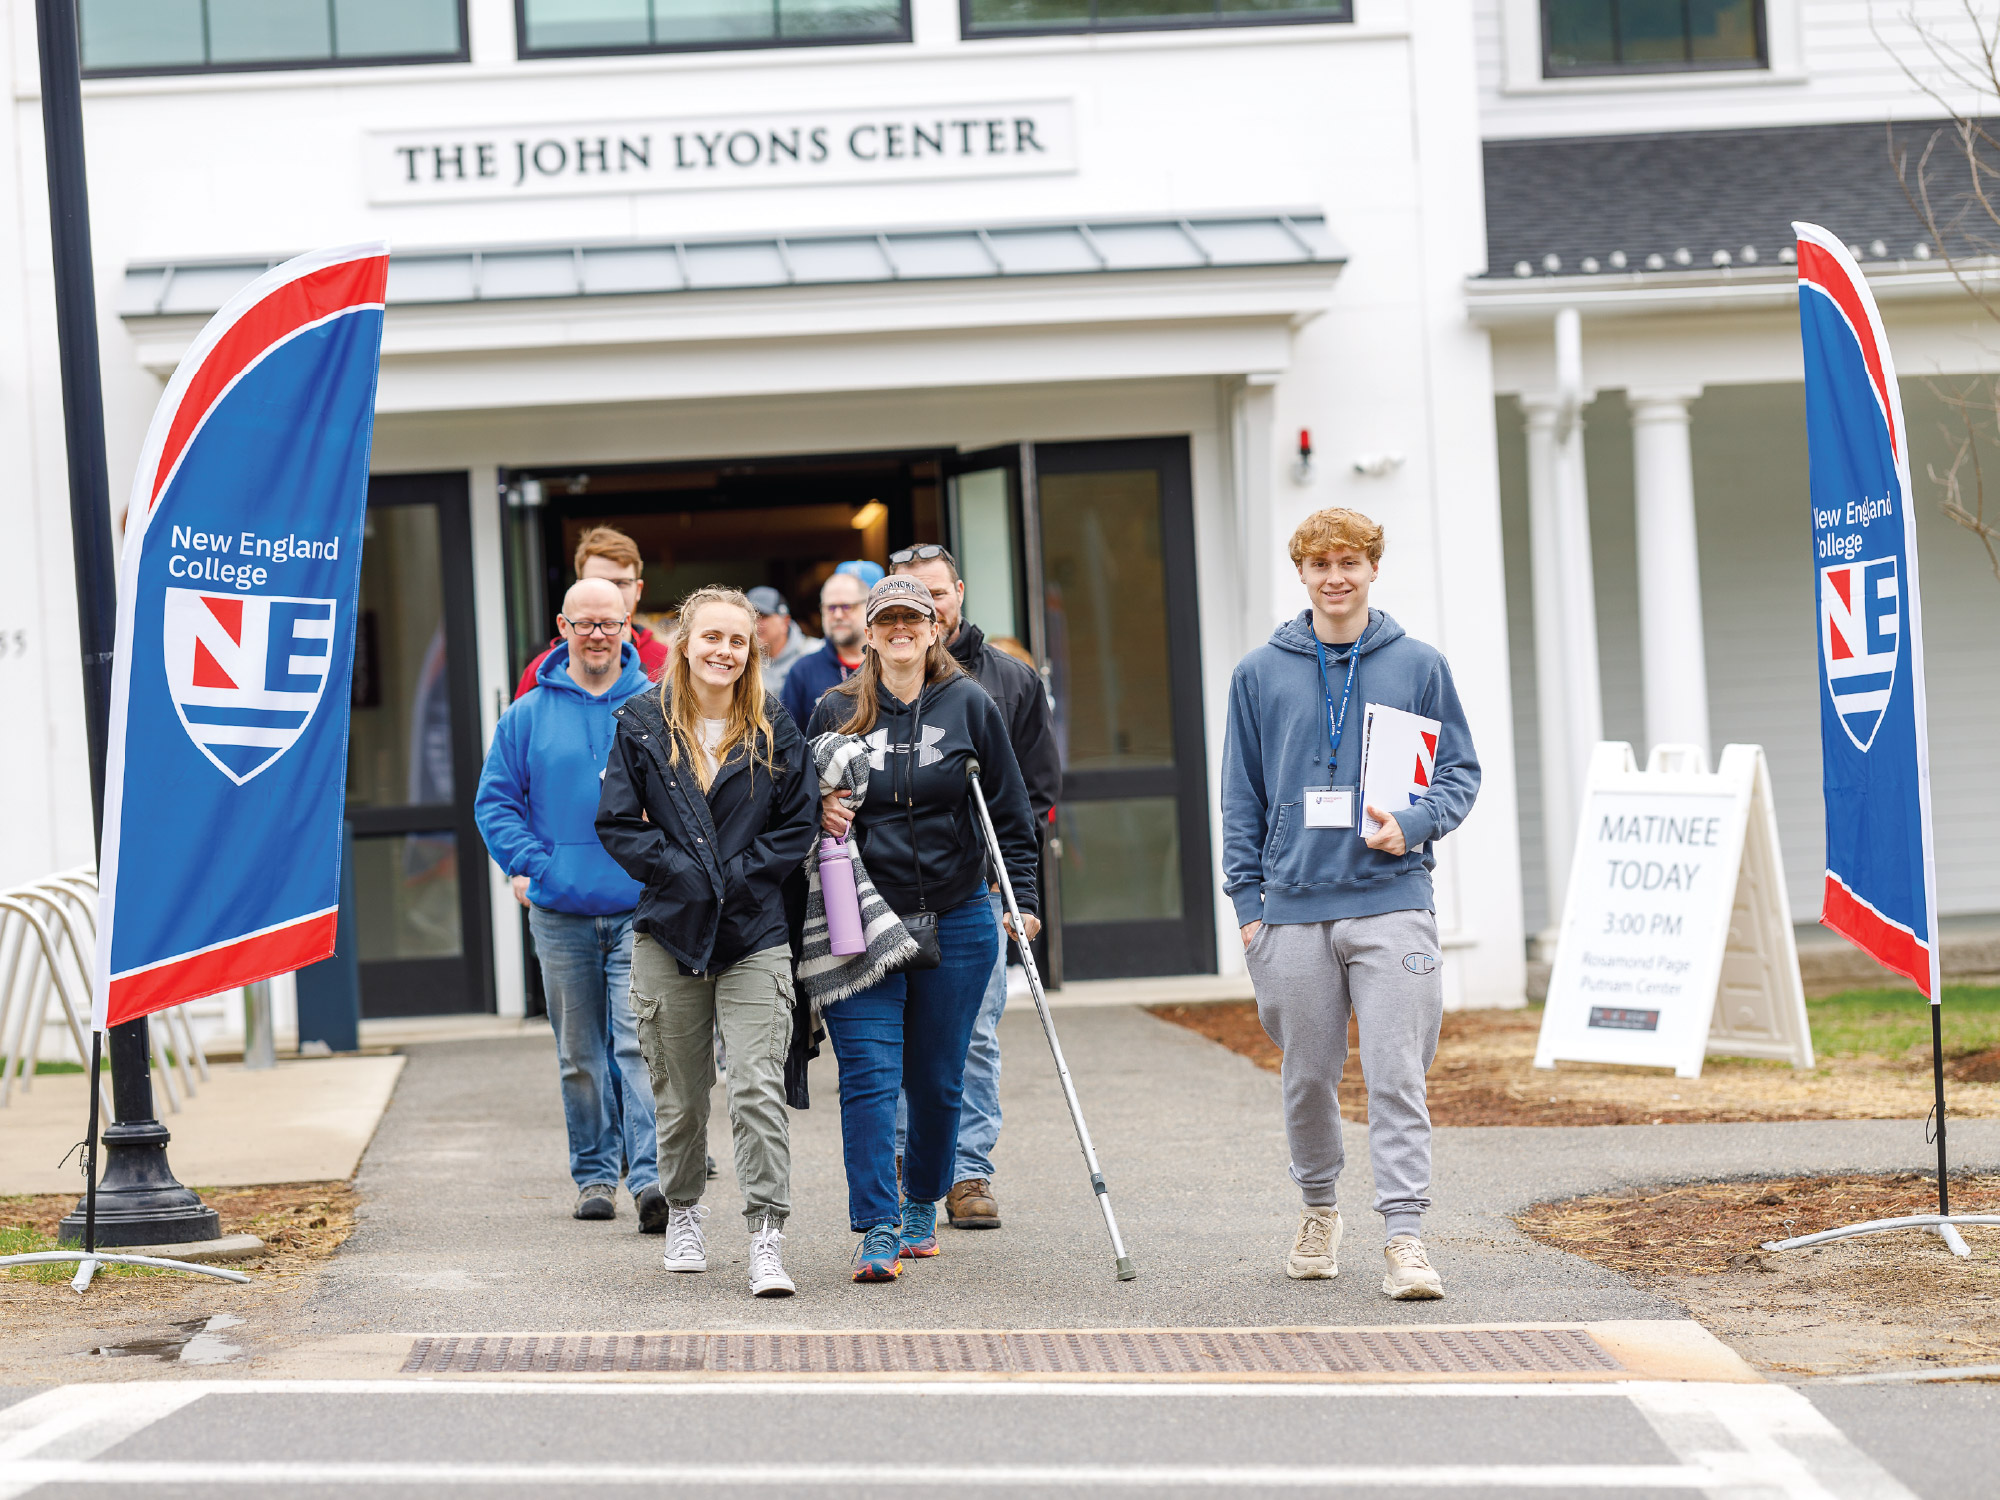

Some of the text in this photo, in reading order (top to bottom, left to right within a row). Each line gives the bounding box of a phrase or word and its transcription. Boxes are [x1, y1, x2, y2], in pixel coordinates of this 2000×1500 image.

[396, 117, 1046, 187] THE JOHN LYONS CENTER
[1846, 490, 1893, 528] England
[171, 525, 339, 562] New England
[1817, 532, 1863, 560] ollege
[168, 555, 268, 590] College
[1599, 814, 1721, 846] MATINEE
[1607, 860, 1701, 891] TODAY
[1603, 912, 1683, 936] 3:00 PM
[1582, 951, 1692, 974] Rosamond Page
[1636, 977, 1682, 996] Center
